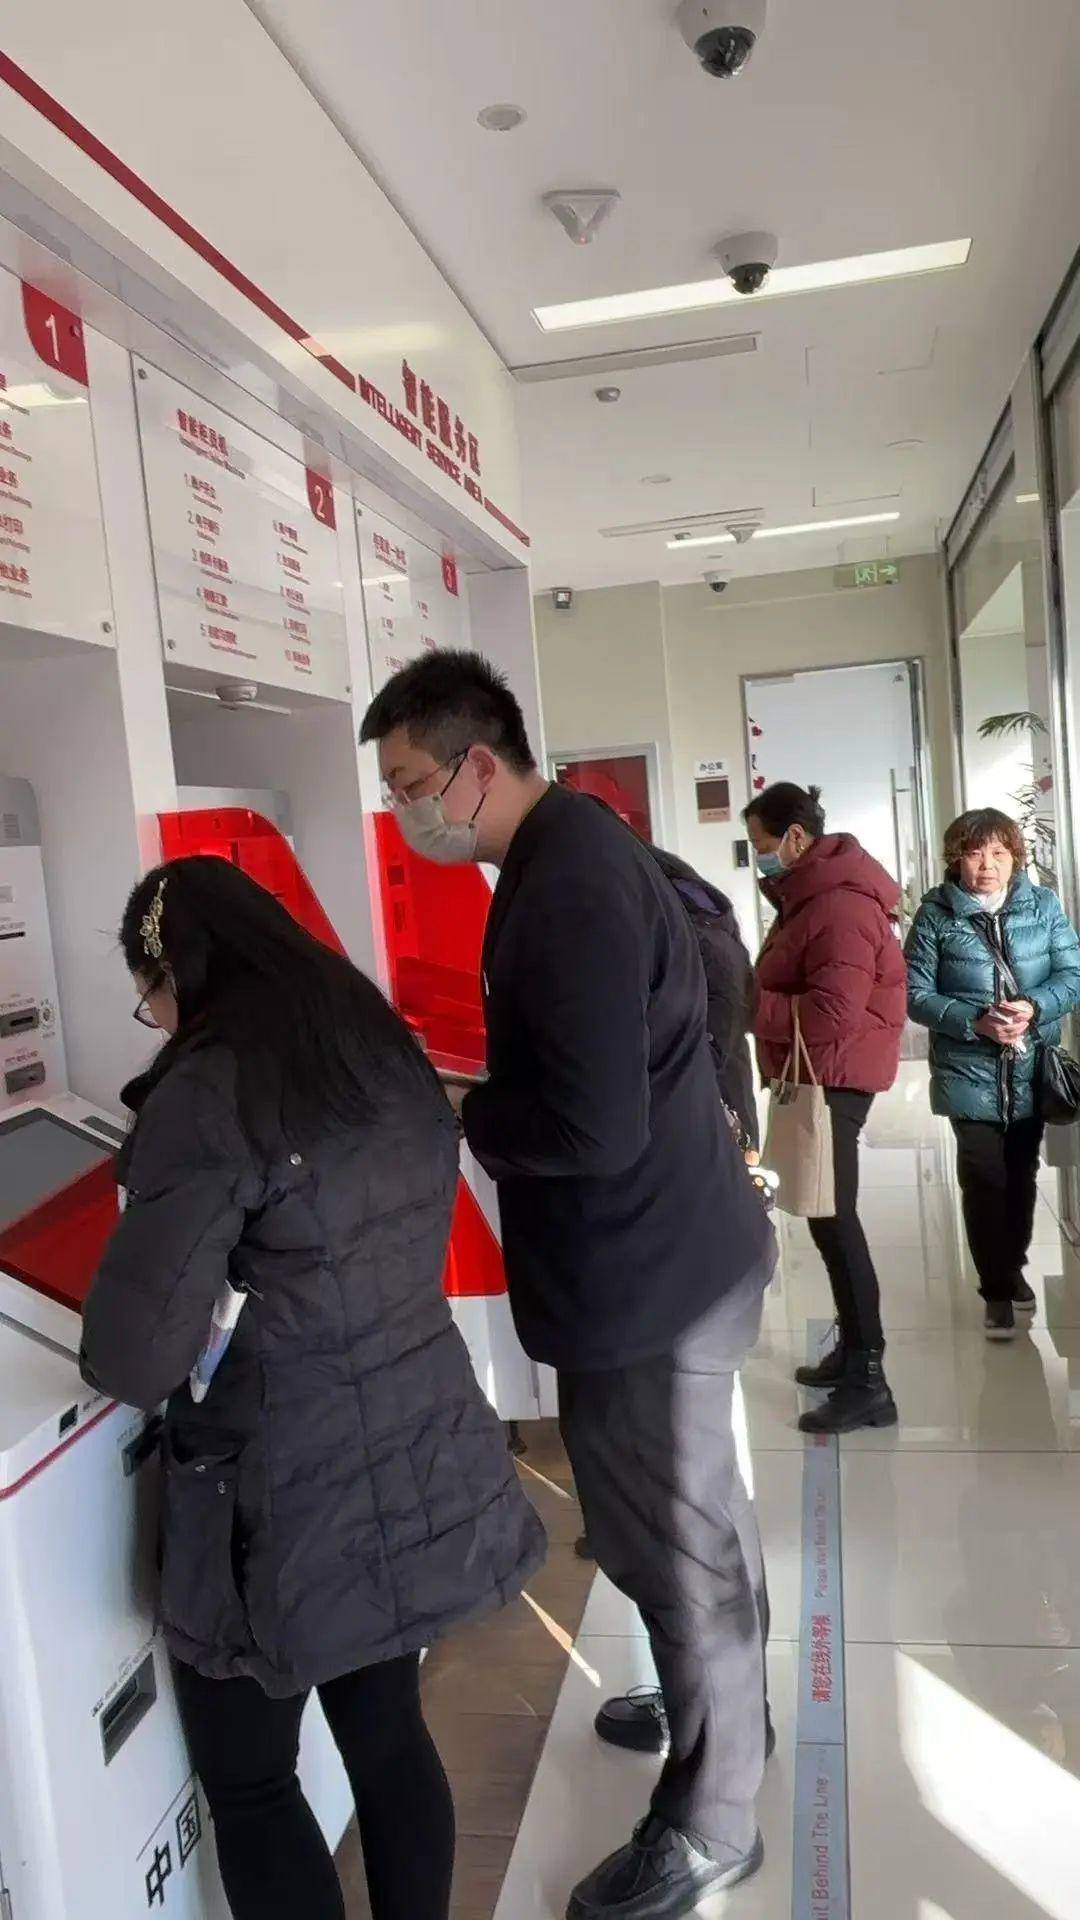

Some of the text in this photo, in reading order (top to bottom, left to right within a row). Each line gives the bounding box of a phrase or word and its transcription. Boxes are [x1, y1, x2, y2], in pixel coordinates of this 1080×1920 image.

[45, 313, 60, 362] 1
[402, 358, 481, 476] 智能服务区
[313, 487, 326, 518] 2
[810, 1615, 831, 1703] 请您在线外等候
[812, 1777, 828, 1807] Line
[145, 1790, 201, 1908] 中国
[812, 1812, 828, 1839] The
[811, 1844, 829, 1900] Behind
